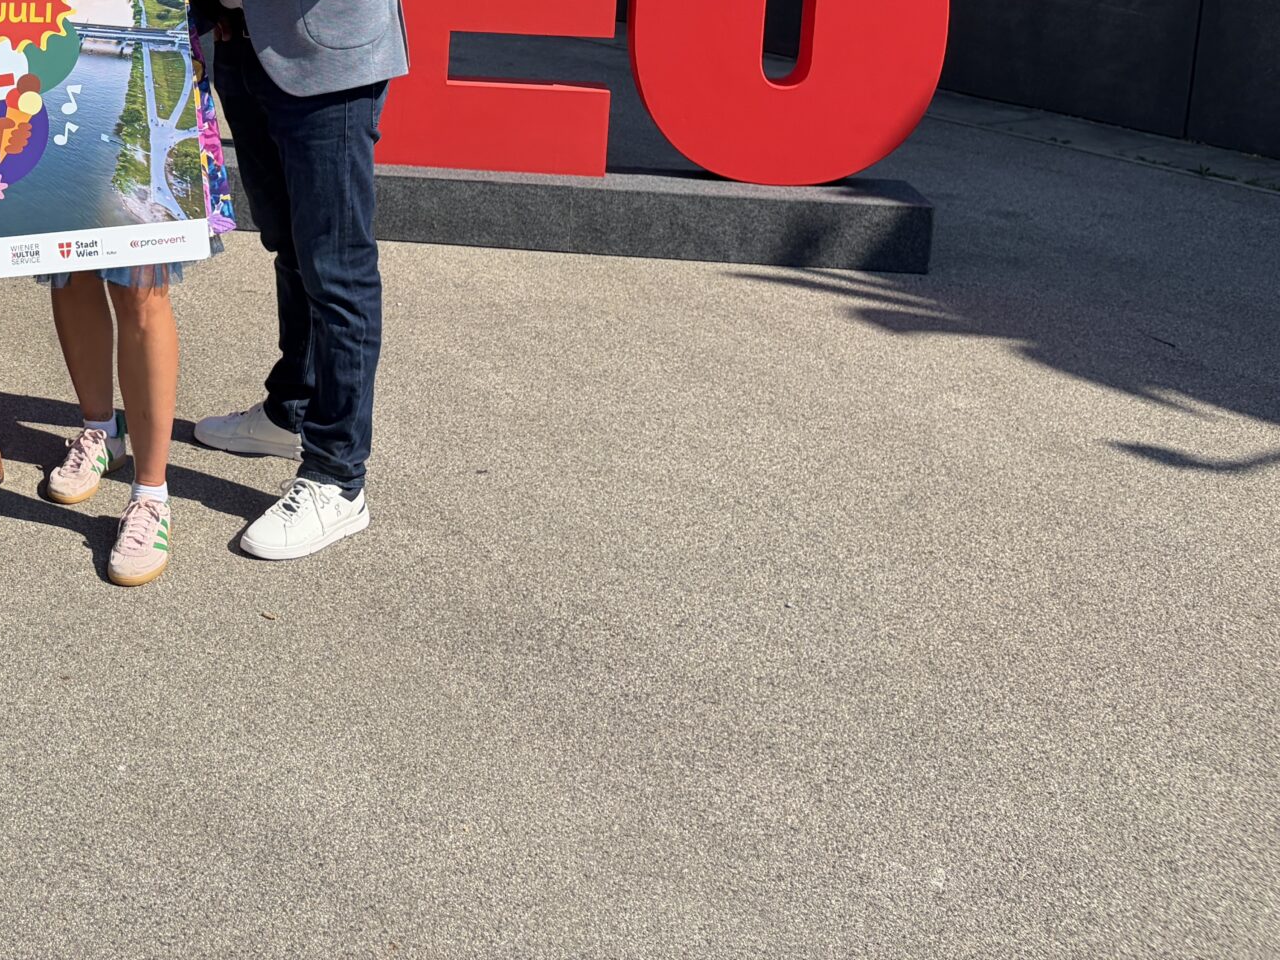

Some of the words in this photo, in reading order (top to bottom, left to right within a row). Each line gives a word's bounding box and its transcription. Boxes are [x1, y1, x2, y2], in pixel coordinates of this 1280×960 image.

[75, 239, 98, 249] Stadt
[140, 235, 187, 248] proevent
[10, 243, 40, 252] WIENER
[11, 250, 40, 259] KULTUR
[75, 248, 99, 258] Wien
[11, 257, 41, 266] SERVICE
